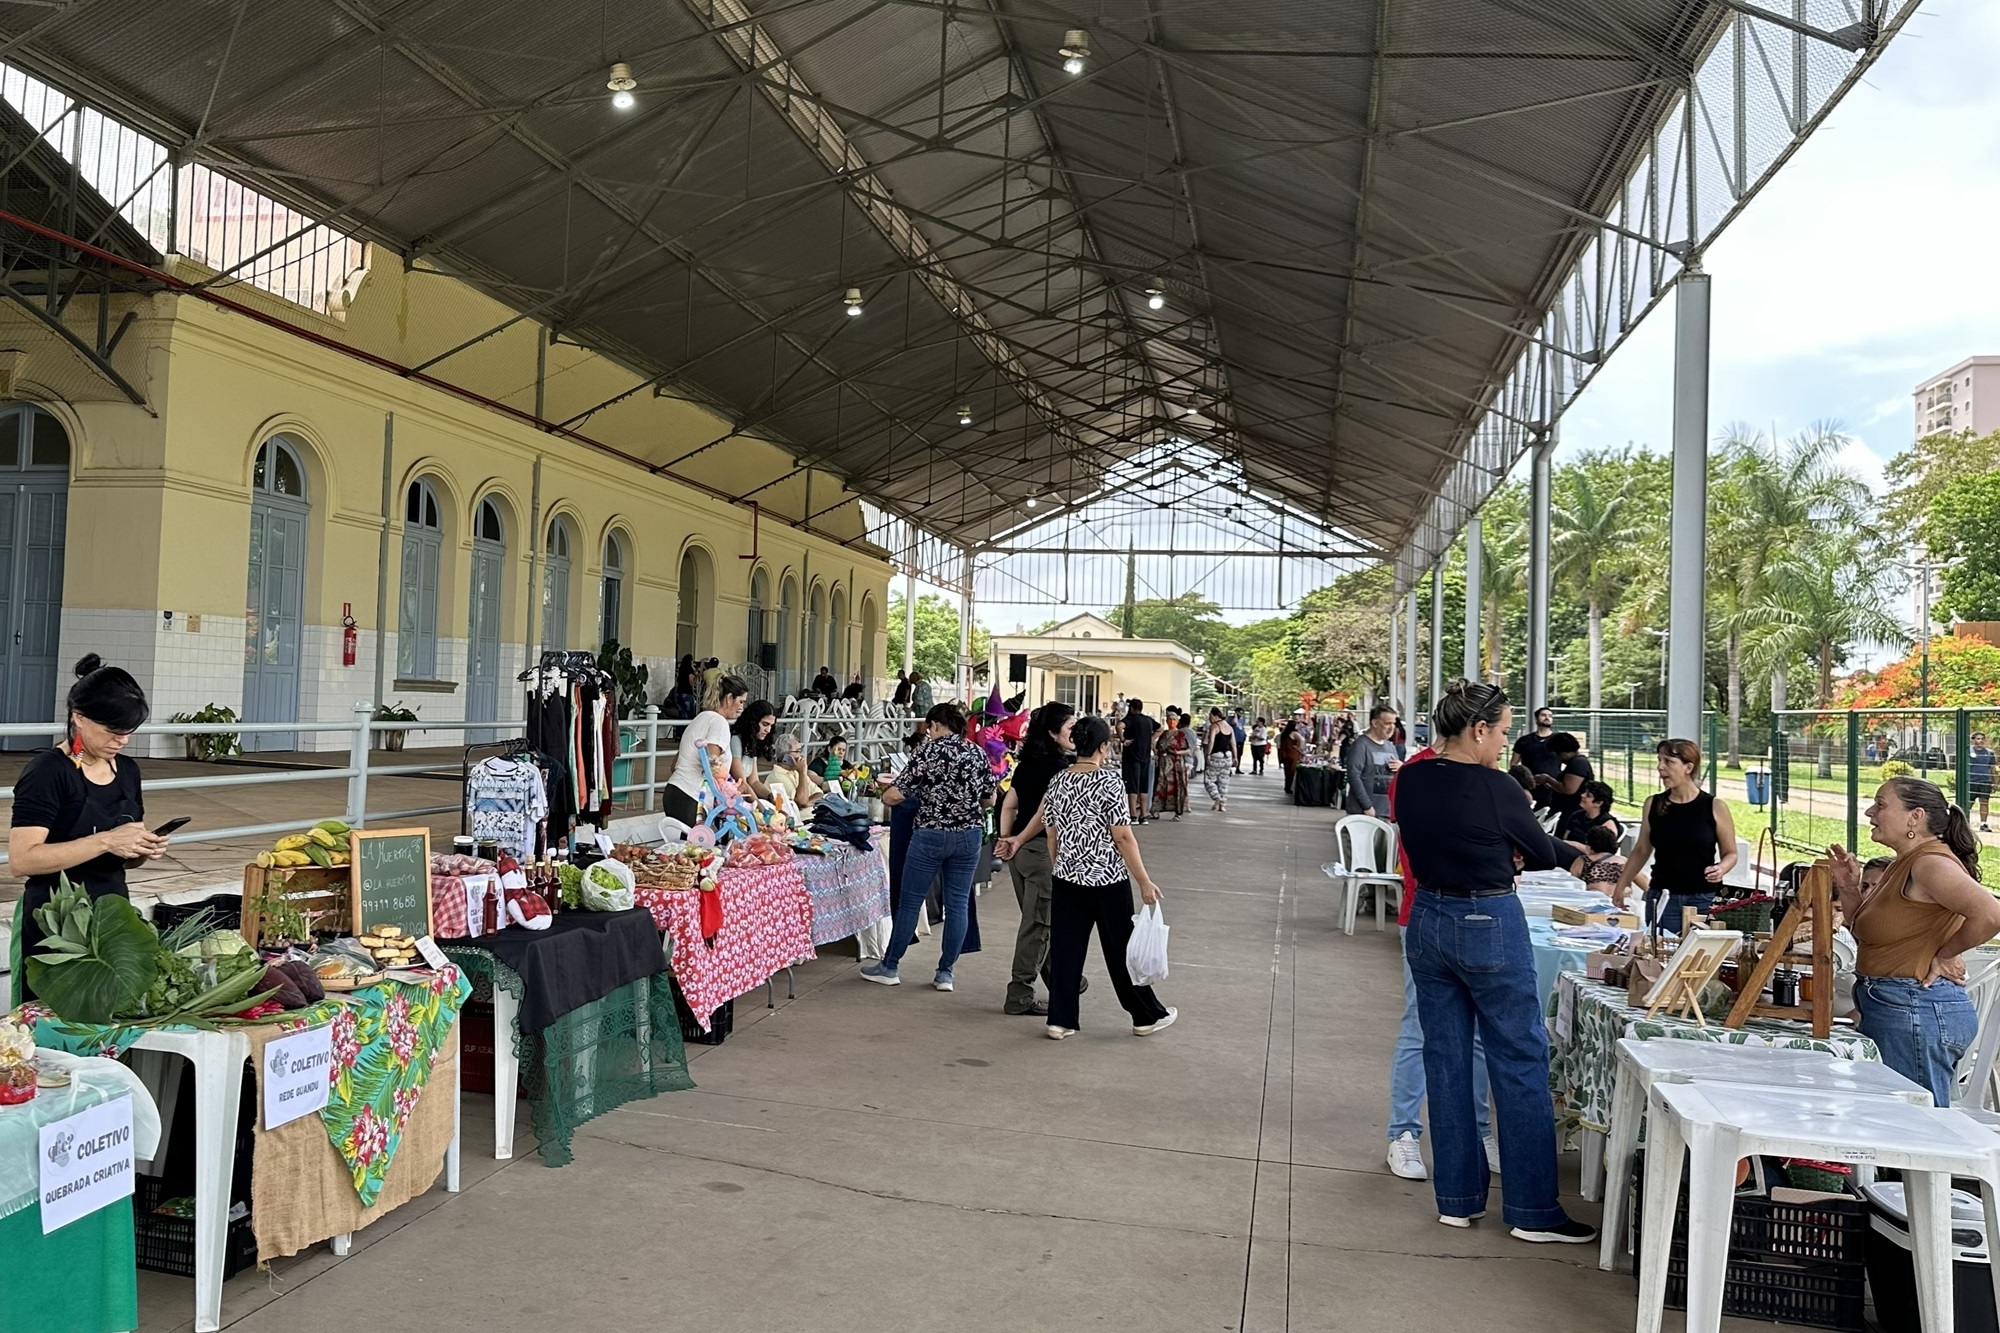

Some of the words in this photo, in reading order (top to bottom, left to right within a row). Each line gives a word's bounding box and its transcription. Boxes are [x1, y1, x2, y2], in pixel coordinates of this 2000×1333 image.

[361, 842, 375, 860] LA
[375, 841, 415, 869] HUERTITA
[393, 894, 416, 910] 8688
[291, 1051, 329, 1074] COLETIVO
[279, 1089, 294, 1103] REDE
[77, 1125, 130, 1160] COLETIVO
[45, 1175, 91, 1204] QUEBRADA
[93, 1158, 130, 1183] CRIATIVA
